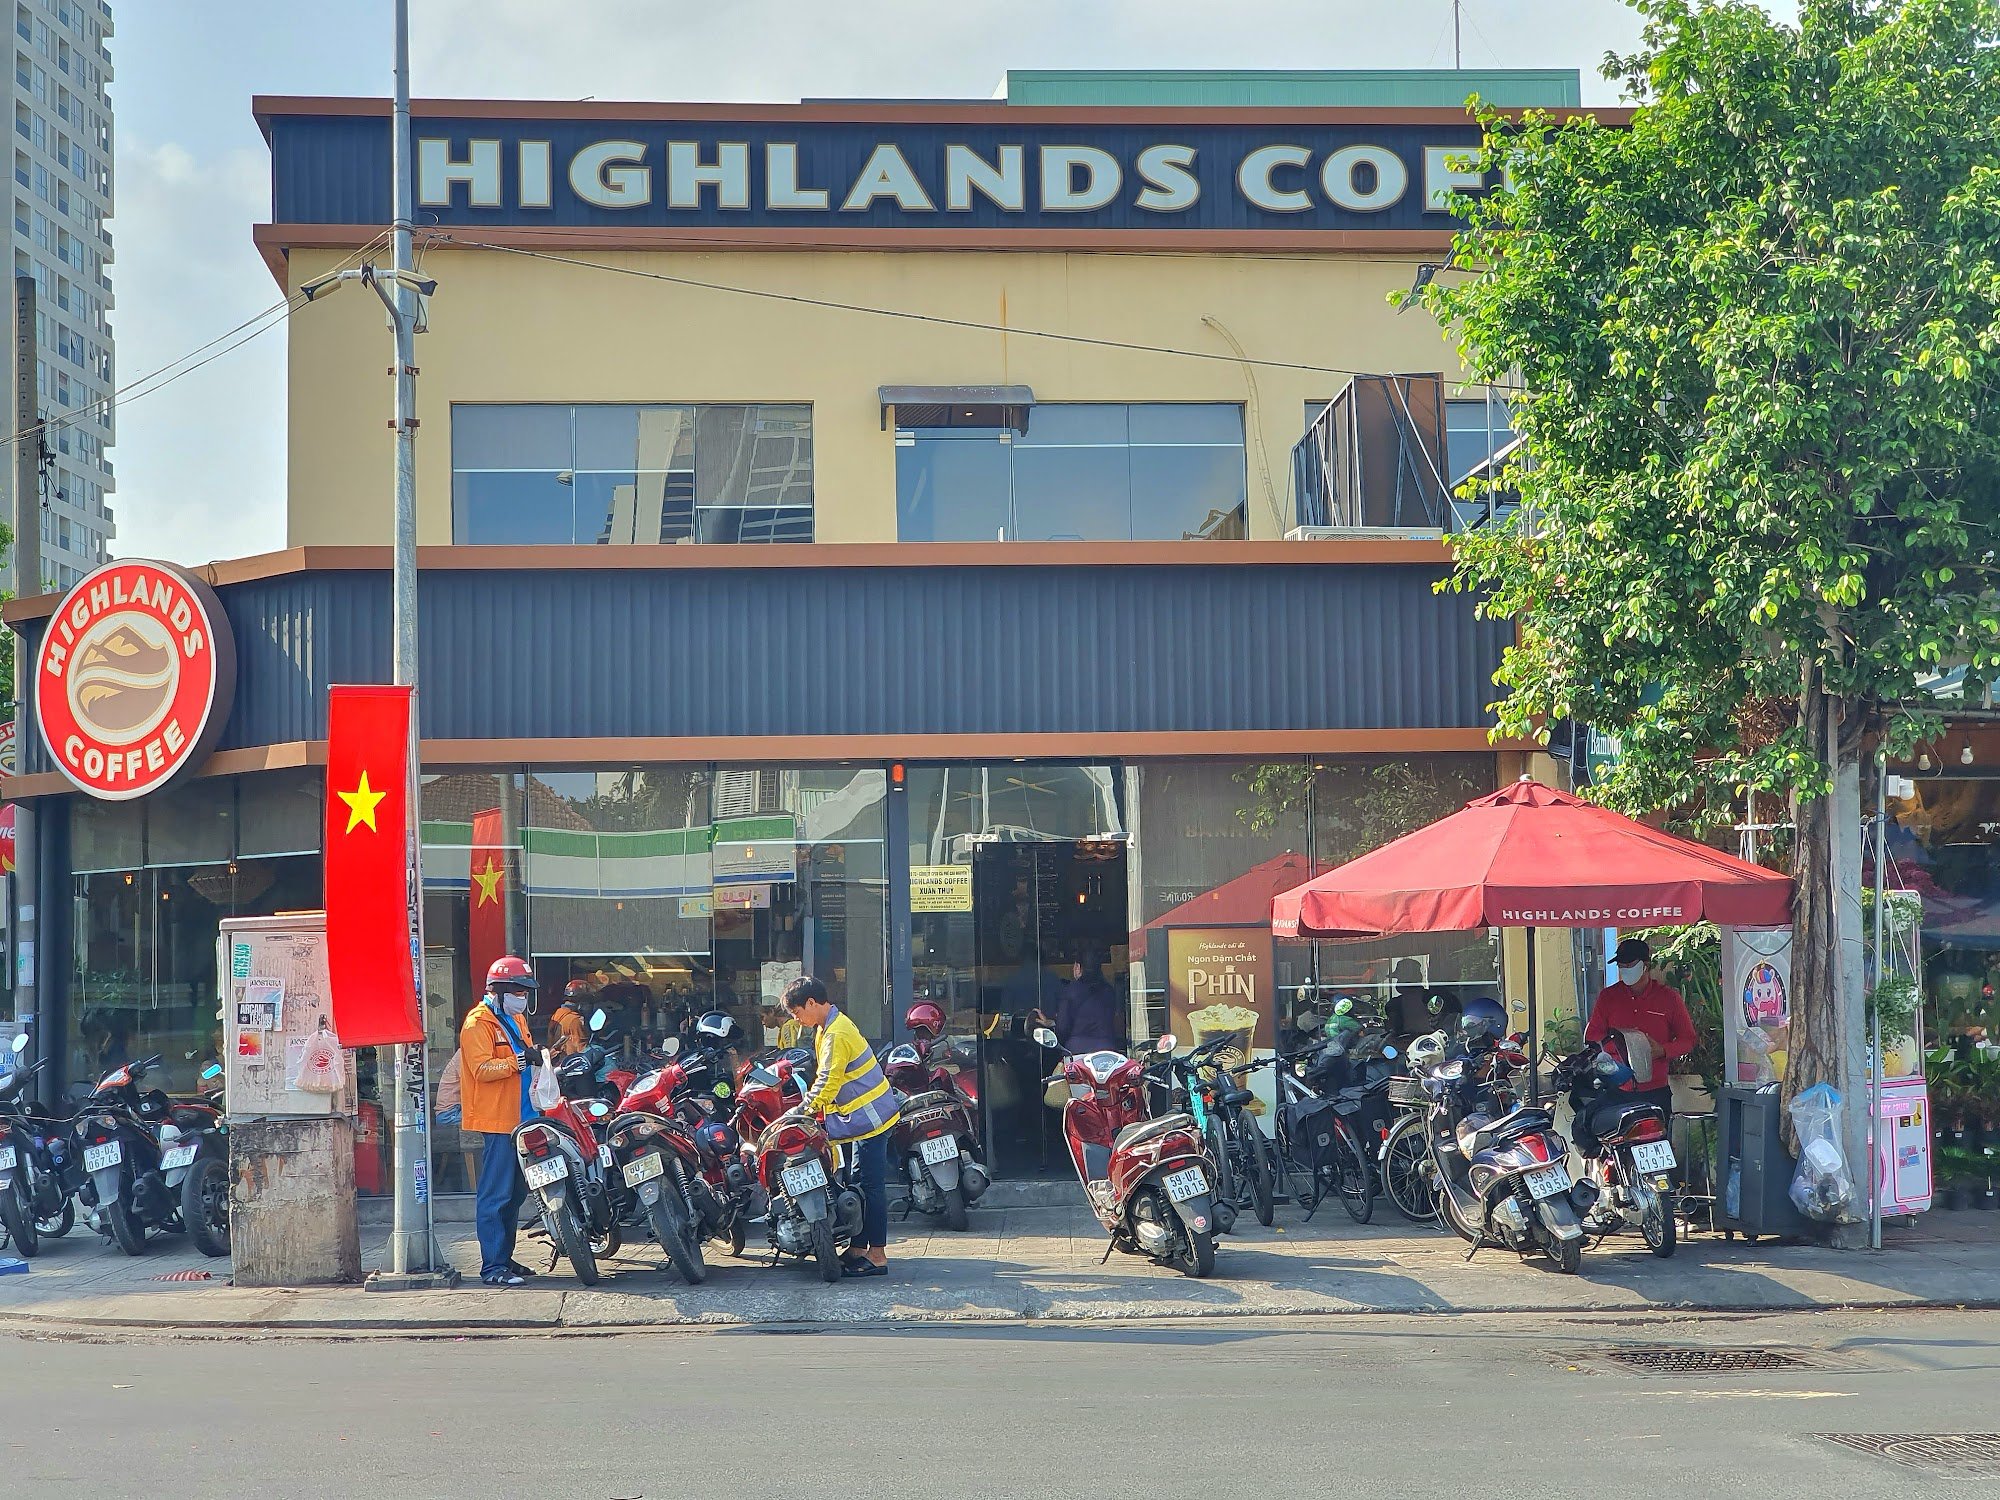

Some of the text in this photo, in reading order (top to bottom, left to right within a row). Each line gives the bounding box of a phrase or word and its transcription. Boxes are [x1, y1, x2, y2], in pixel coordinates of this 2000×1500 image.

[417, 138, 1540, 214] HIGHLANDS COF
[47, 575, 203, 677] HIGHLANDS
[65, 718, 186, 782] COFFEE
[944, 877, 968, 885] COFFEE
[1502, 906, 1683, 921] HIGHLANDS COFFEE
[1187, 955, 1211, 965] Ngon
[1212, 954, 1233, 964] Đậm
[1188, 967, 1256, 1004] PHIN
[926, 1141, 950, 1151] 60-H1
[1638, 1143, 1665, 1158] 67-M1
[88, 1152, 119, 1170] 067.43
[925, 1150, 956, 1163] 243.05
[1639, 1154, 1674, 1171] 419.75
[530, 1166, 566, 1188] 423.15
[788, 1163, 816, 1182] 59-Z1
[1169, 1169, 1198, 1188] 59-U2
[1530, 1166, 1559, 1184] 59-S1
[789, 1173, 825, 1194] 033.85
[1171, 1179, 1206, 1201] 198.15
[1532, 1177, 1569, 1197] 599.54
